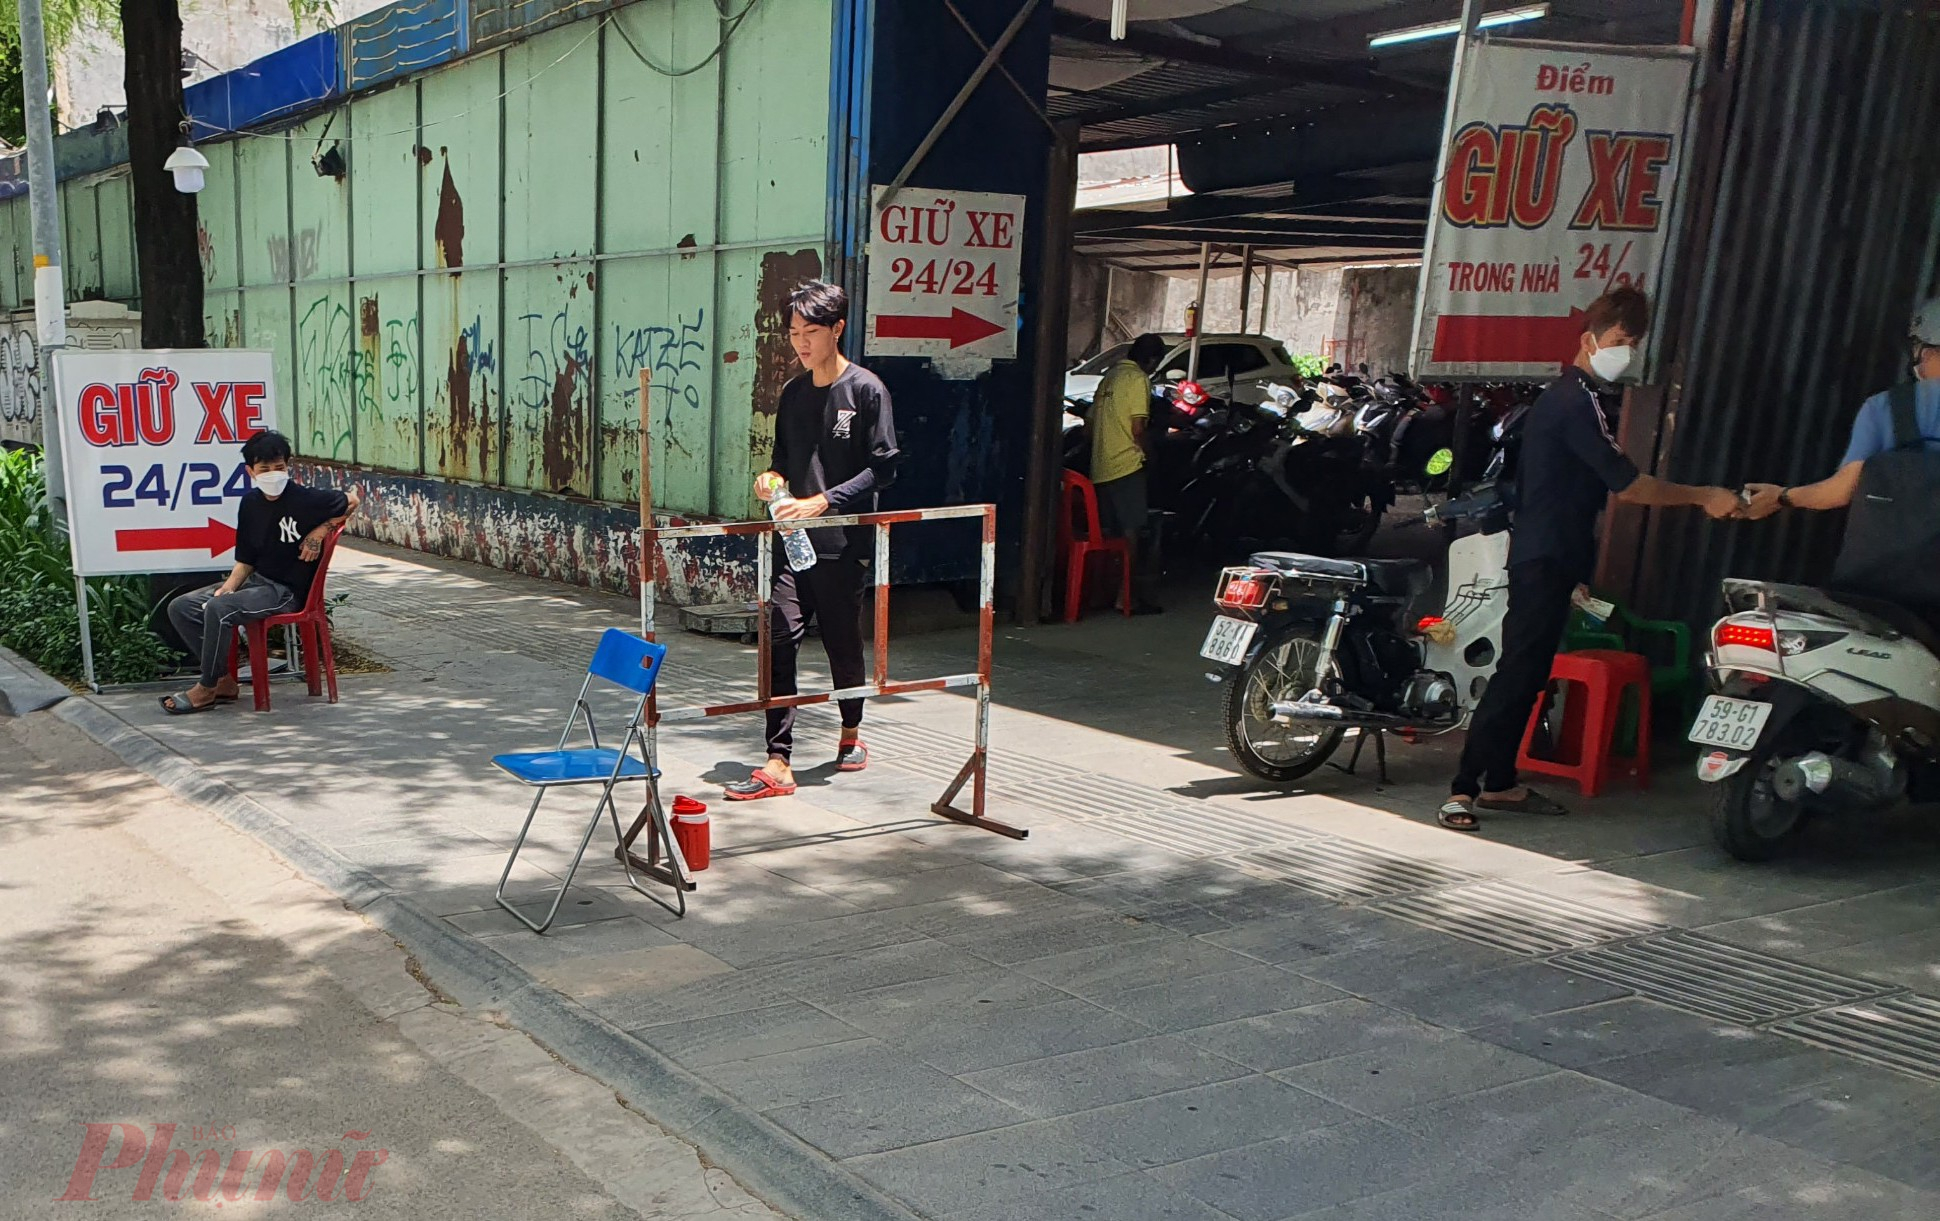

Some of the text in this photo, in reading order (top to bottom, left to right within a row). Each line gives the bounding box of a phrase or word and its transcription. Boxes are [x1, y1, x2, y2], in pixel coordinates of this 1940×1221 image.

[1536, 62, 1615, 95] Điểm
[1442, 102, 1674, 232] GIỮ XE
[880, 198, 1014, 249] GIỮ XE
[889, 257, 999, 296] 24/24
[1448, 262, 1517, 293] TRONG
[1519, 252, 1560, 294] NHÀ
[78, 366, 180, 447] GIỮ
[191, 381, 269, 445] XE
[279, 516, 302, 543] NY
[1710, 699, 1759, 724] 59-G1
[1694, 719, 1756, 747] 783.02
